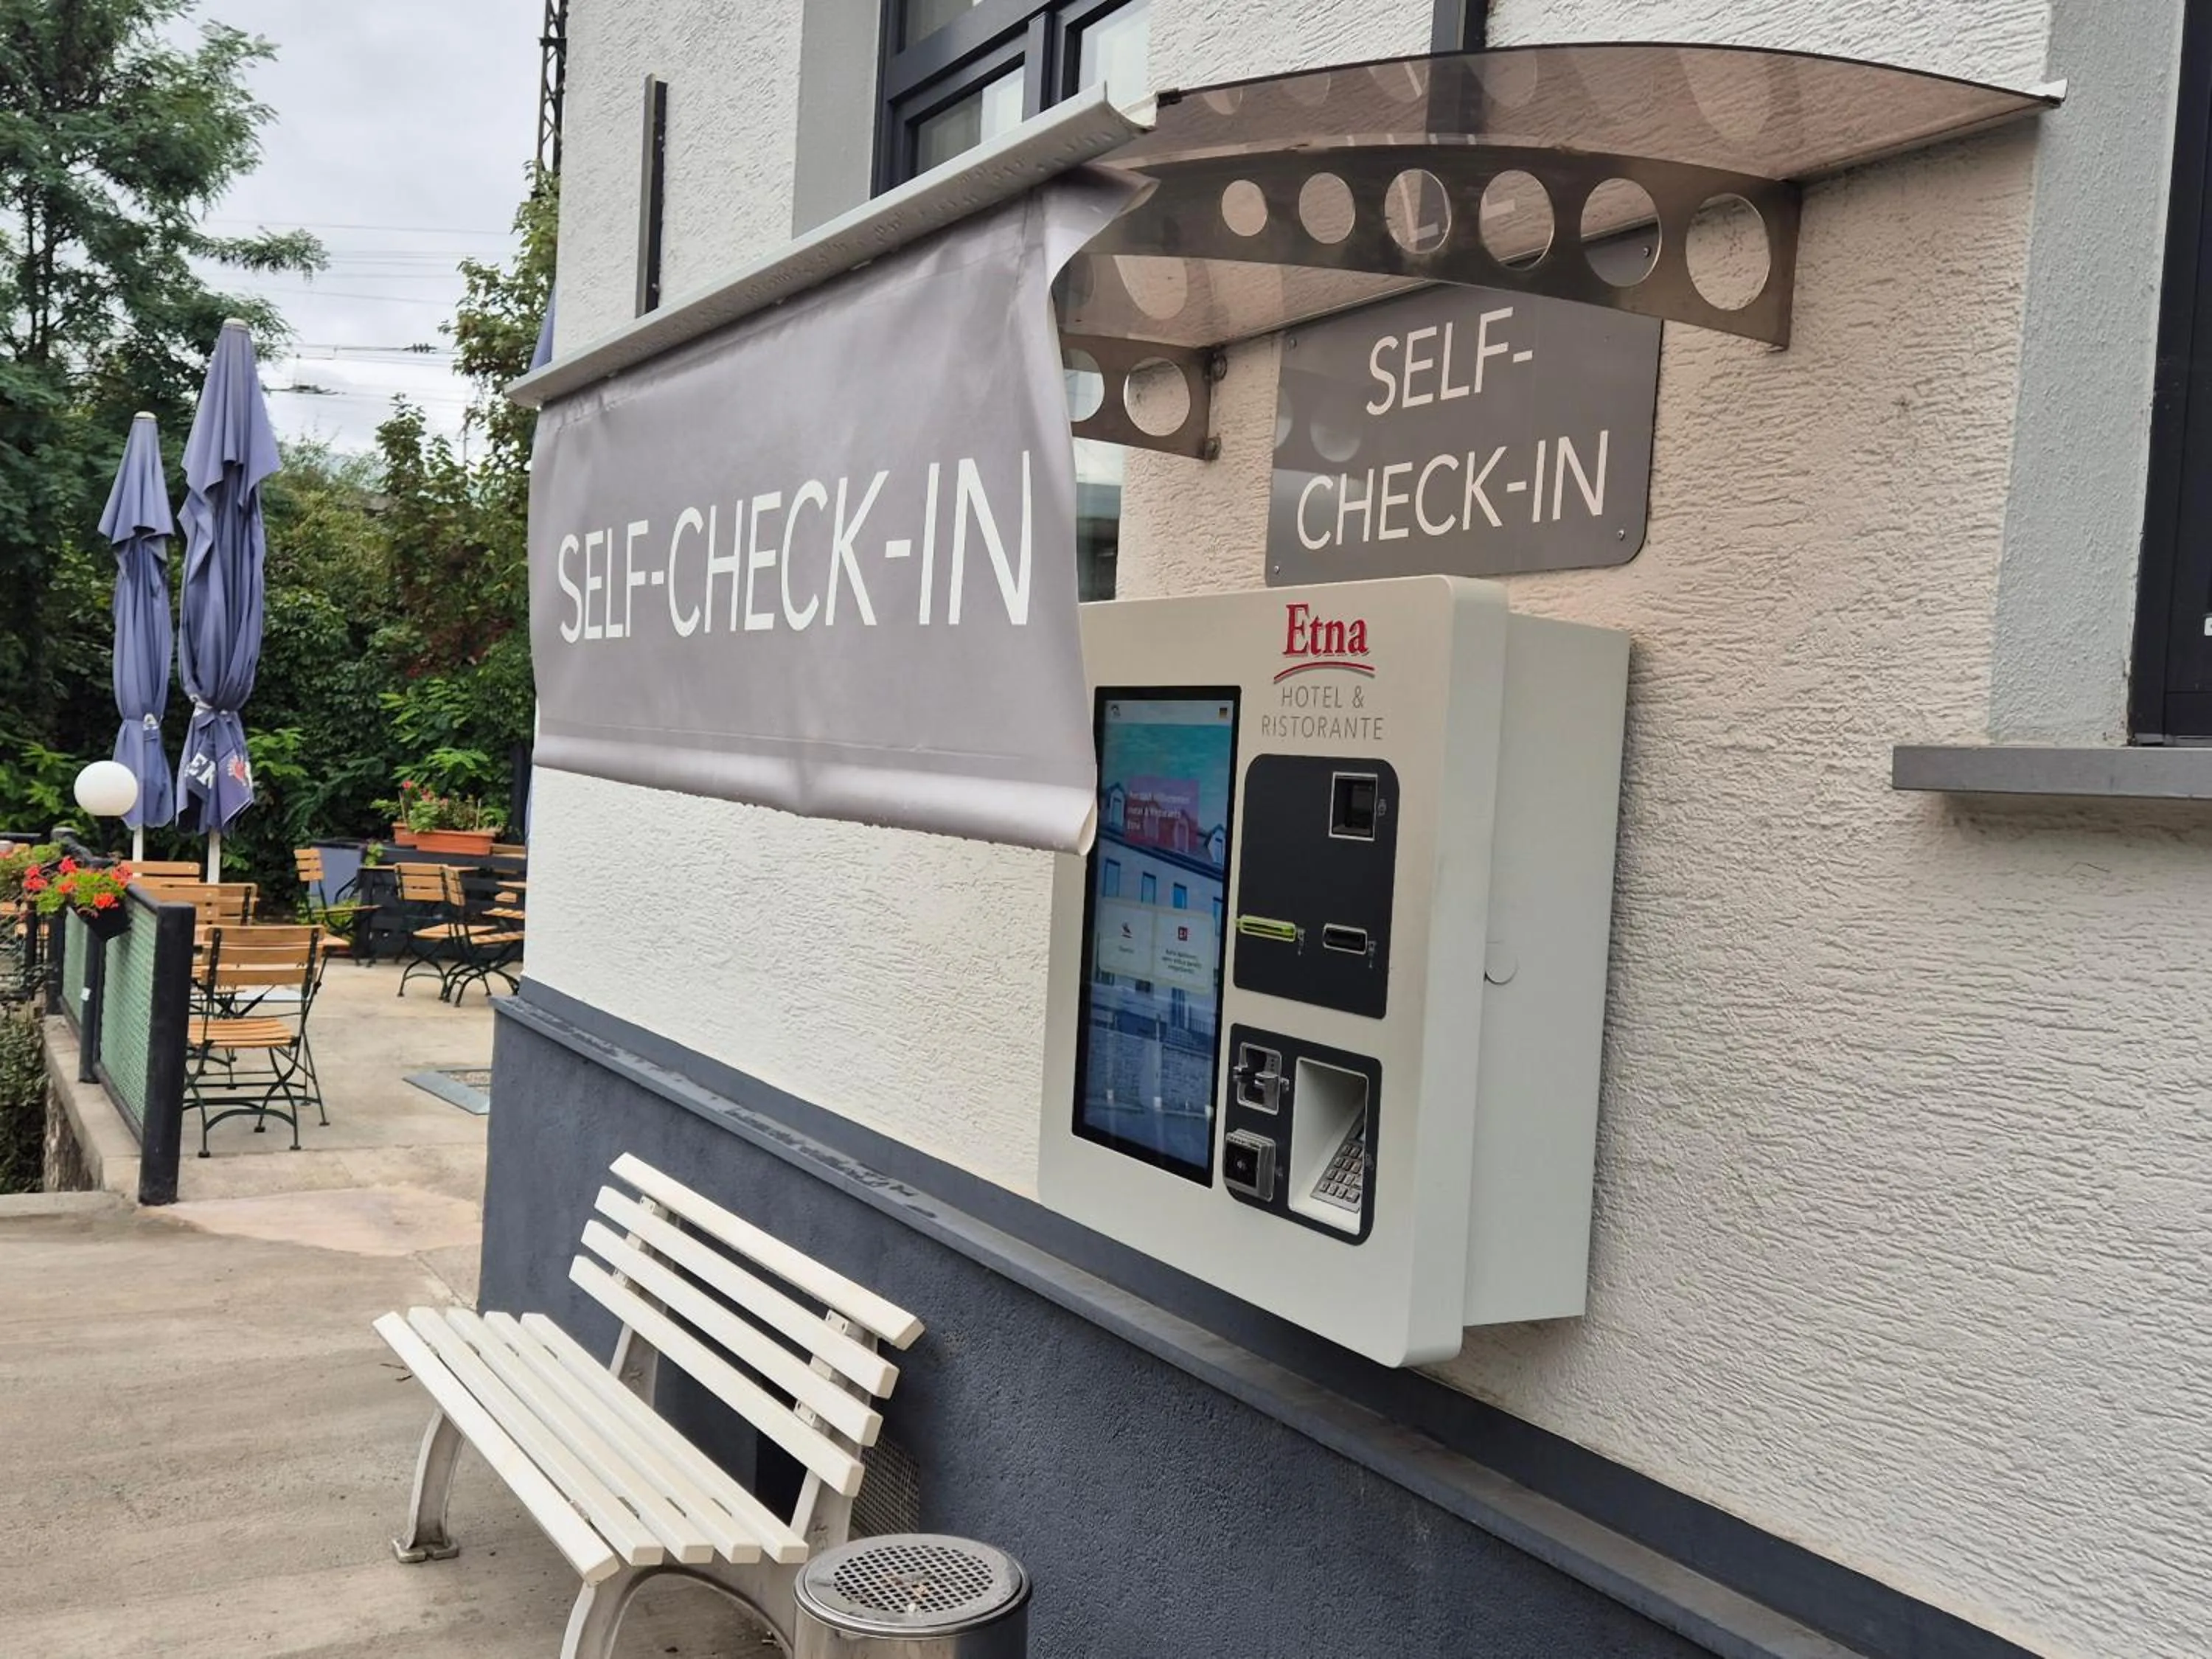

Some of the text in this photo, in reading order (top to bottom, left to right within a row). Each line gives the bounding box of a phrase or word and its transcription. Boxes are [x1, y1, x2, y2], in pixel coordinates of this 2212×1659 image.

[1366, 306, 1534, 416] SELF-
[1296, 429, 1609, 550] CHECK-IN
[557, 450, 1032, 644] SELF-CHECK-IN
[1282, 603, 1369, 655] Etna
[1261, 714, 1385, 740] RISTORANTE
[1281, 685, 1365, 709] HOTEL &
